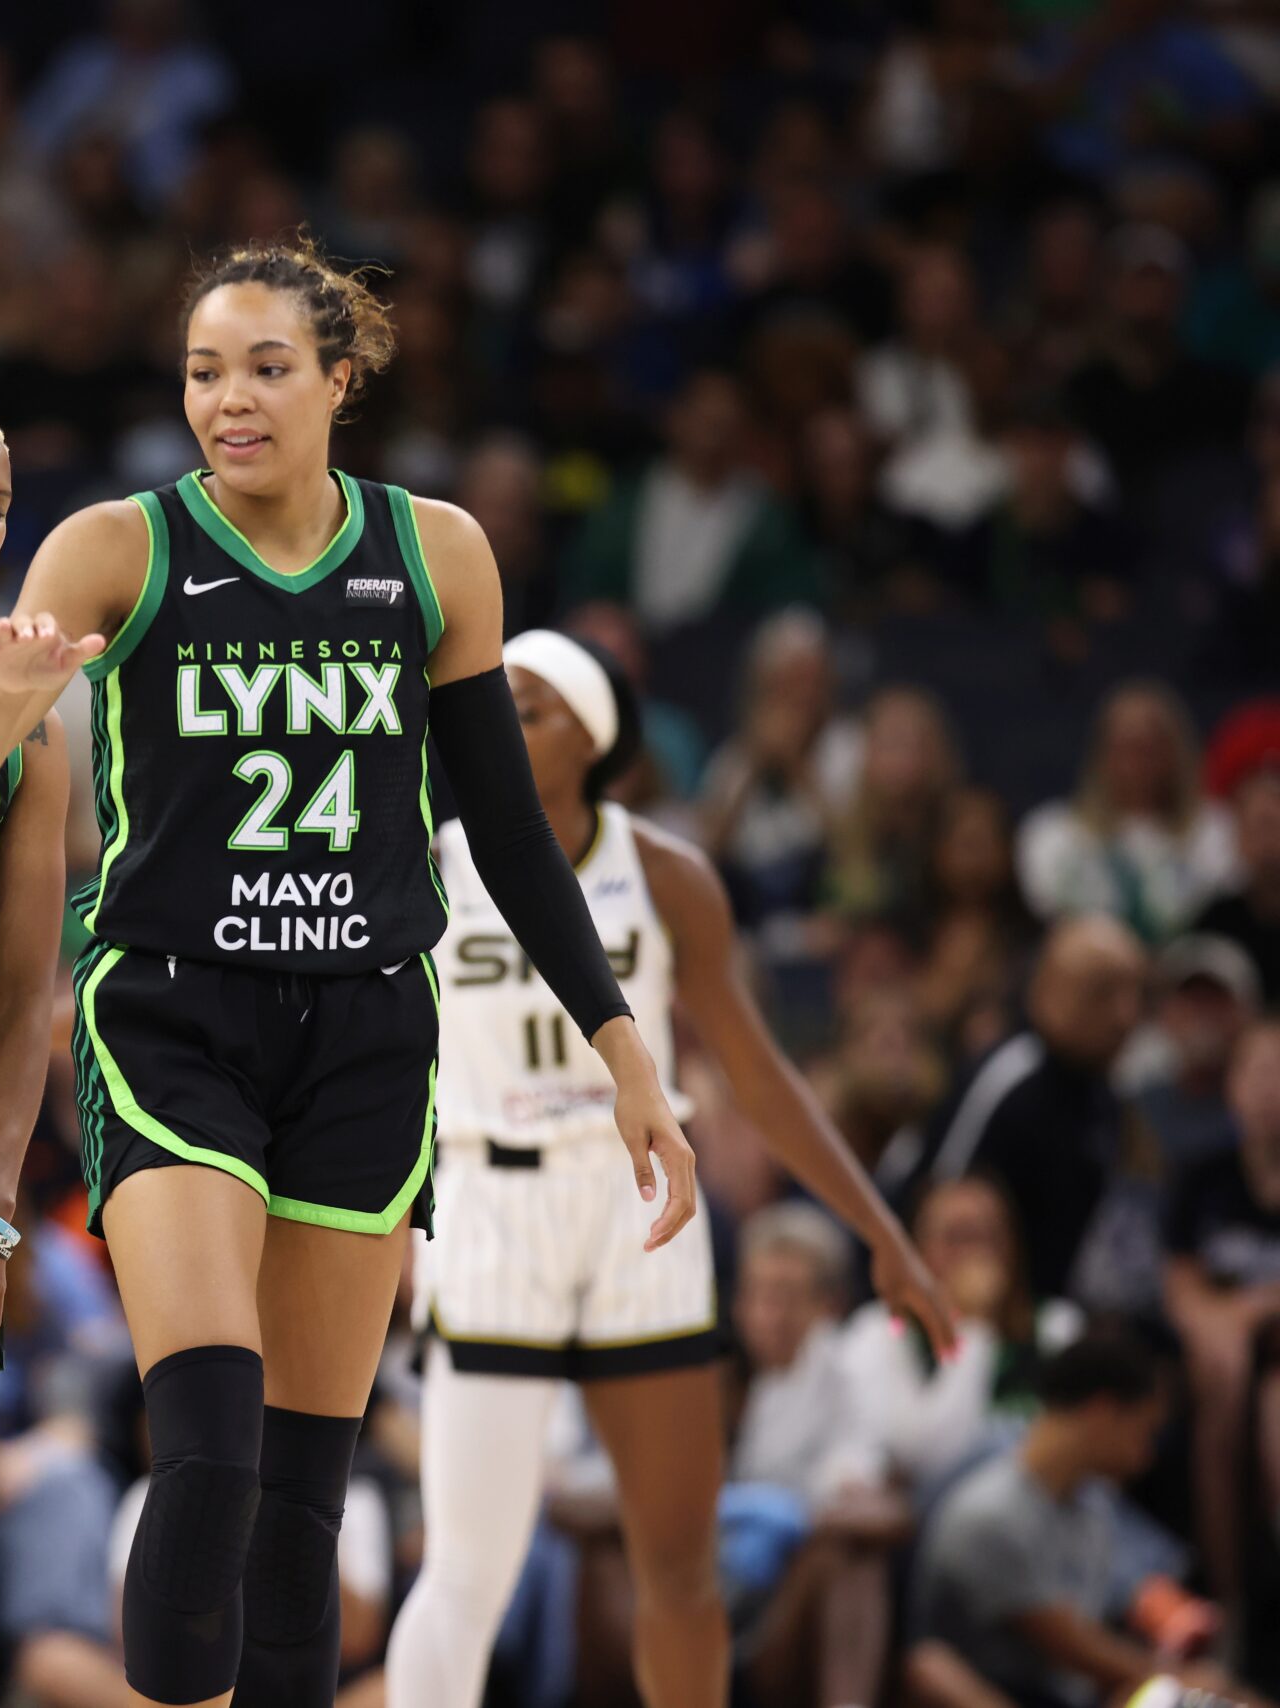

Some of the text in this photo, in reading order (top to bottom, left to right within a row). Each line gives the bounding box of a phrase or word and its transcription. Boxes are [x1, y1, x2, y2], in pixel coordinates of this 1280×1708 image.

[345, 590, 387, 599] INSURANCE
[347, 579, 404, 592] FEDERATED
[177, 640, 402, 660] MINNESOTA
[177, 663, 402, 736] LYNX
[227, 749, 360, 851] 24
[231, 872, 354, 907] MAYO
[213, 914, 370, 951] CLINIC
[453, 928, 640, 987] SY
[523, 1010, 566, 1071] 11
